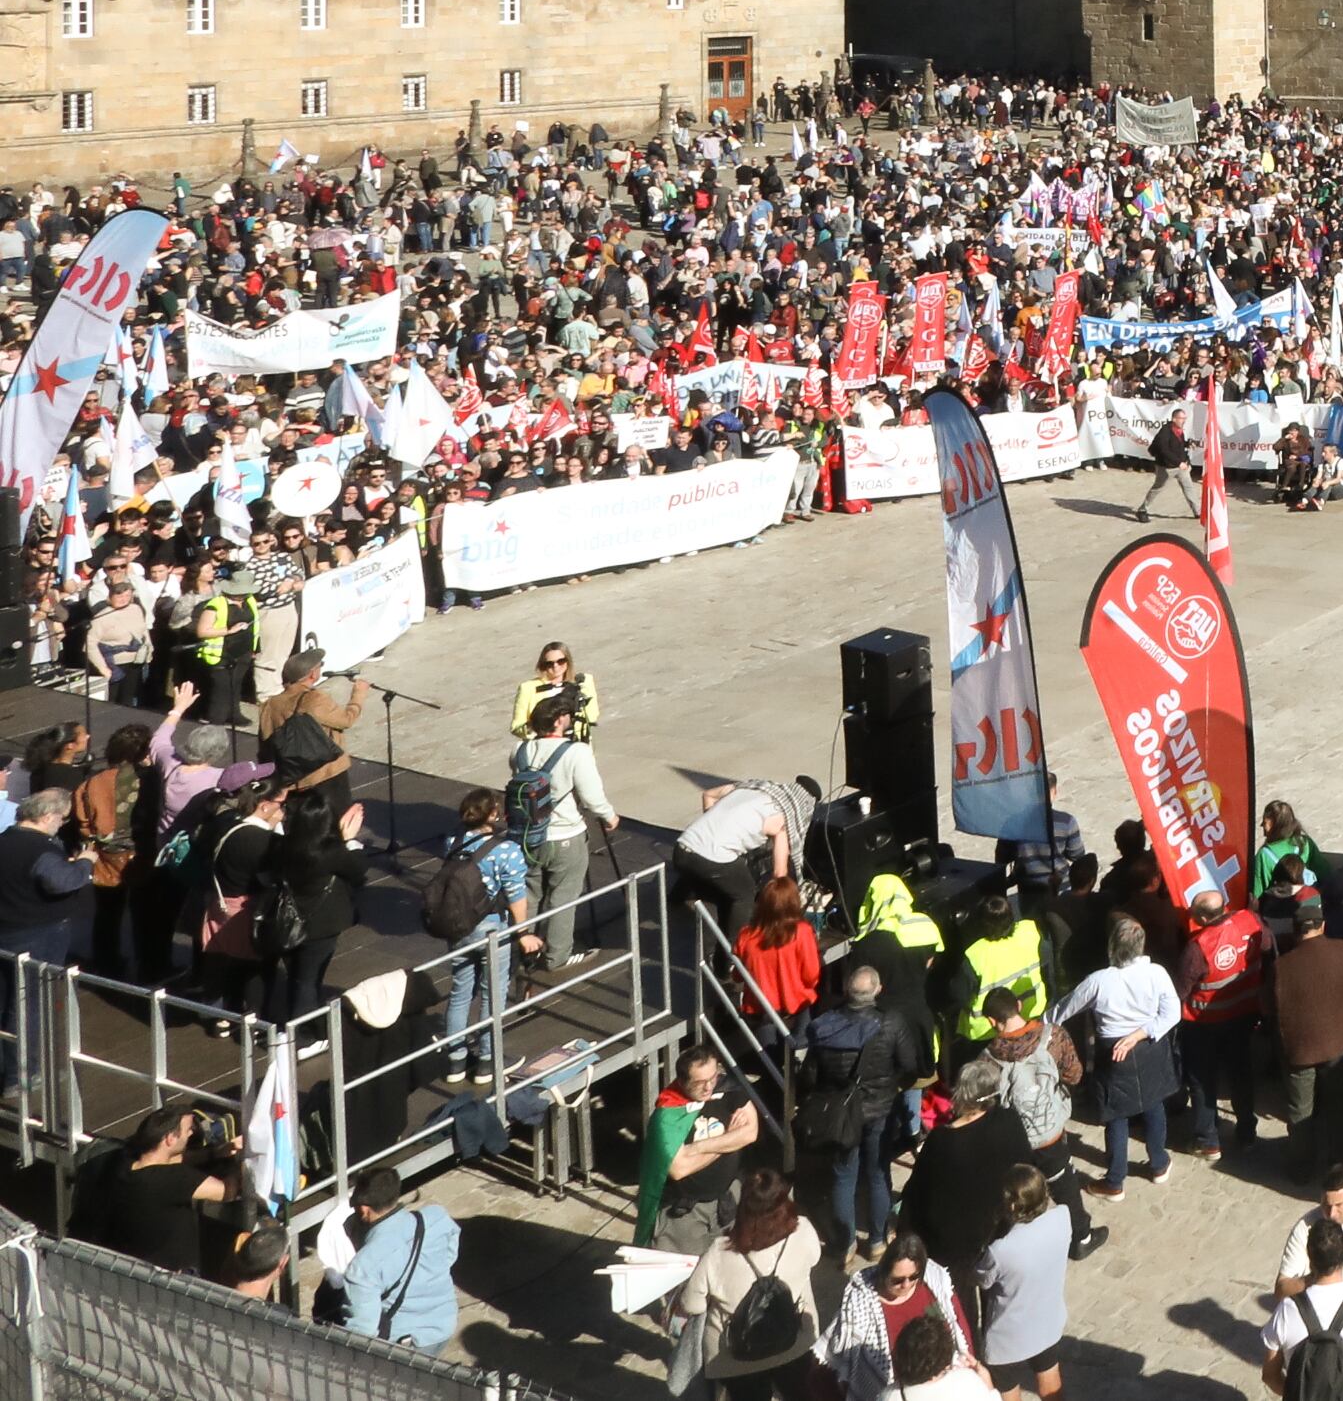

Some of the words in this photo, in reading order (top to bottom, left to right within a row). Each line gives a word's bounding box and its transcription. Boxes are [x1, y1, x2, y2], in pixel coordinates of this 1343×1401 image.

[188, 320, 224, 338] ESTES
[920, 309, 938, 361] UGT
[1086, 323, 1114, 341] EN
[1119, 322, 1208, 340] DEFENSA
[844, 328, 870, 380] UGT
[667, 476, 740, 510] pública
[460, 531, 520, 564] bng
